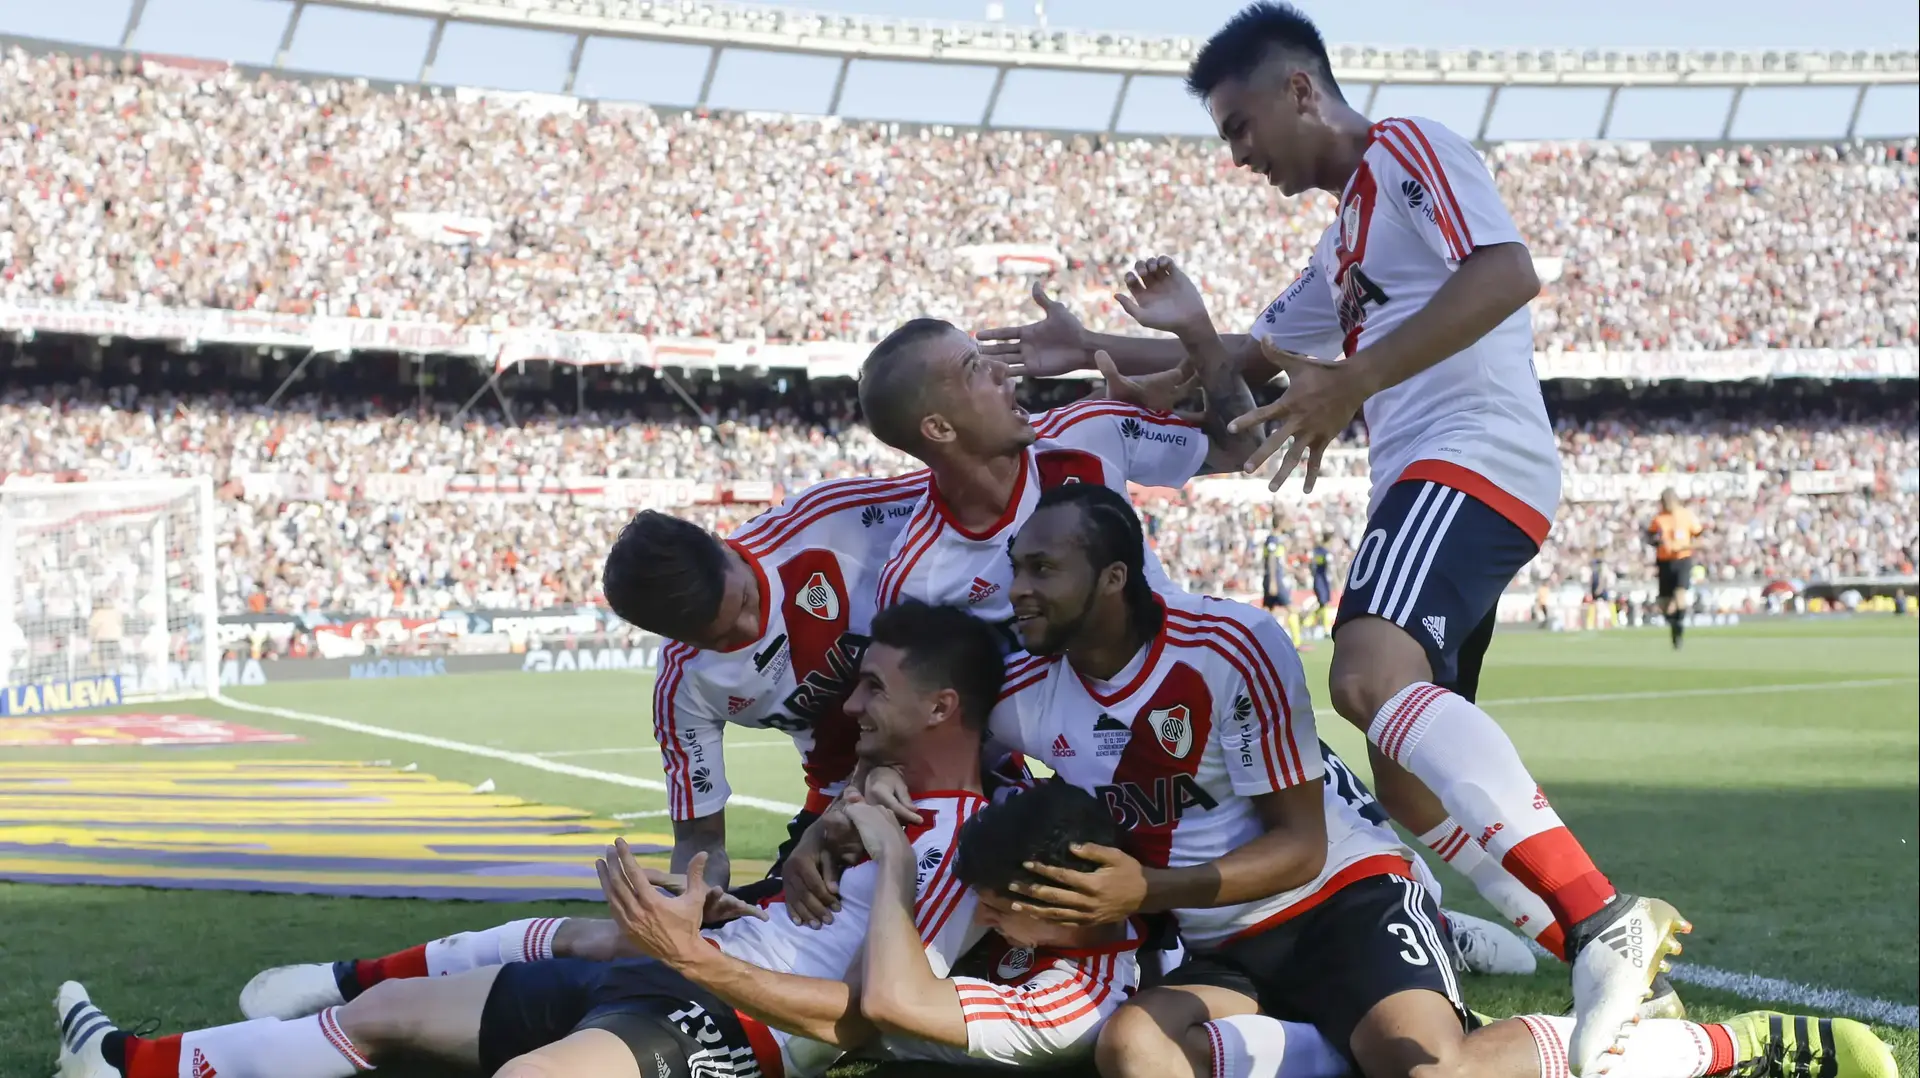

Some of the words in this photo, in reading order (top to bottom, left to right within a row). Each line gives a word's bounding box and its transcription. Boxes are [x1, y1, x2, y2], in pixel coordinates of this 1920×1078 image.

[1140, 427, 1187, 446] HUAWEI
[888, 504, 916, 519] HUA
[968, 583, 1001, 605] adidas
[1422, 617, 1445, 649] adidas
[8, 684, 42, 715] LA
[42, 677, 118, 711] NUEVA
[685, 728, 705, 763] HUEI
[1094, 772, 1219, 832] BVA
[1387, 923, 1430, 966] 3
[1632, 917, 1644, 968] adidas
[192, 1047, 202, 1078] adid
[654, 1052, 664, 1078] adid
